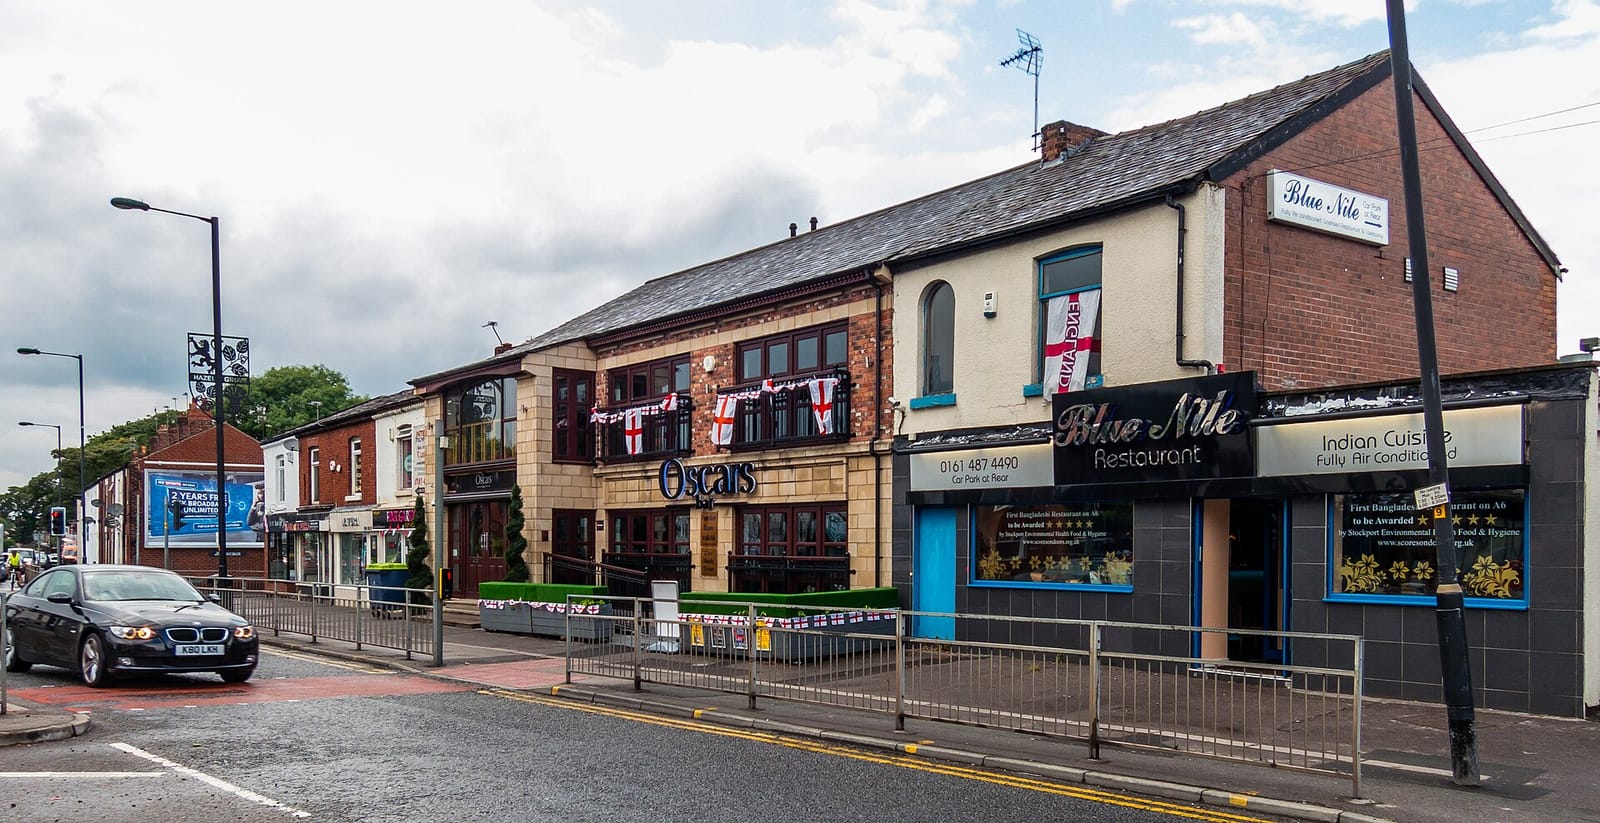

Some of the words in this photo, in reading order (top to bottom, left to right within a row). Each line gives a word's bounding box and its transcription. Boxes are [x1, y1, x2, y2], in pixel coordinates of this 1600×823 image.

[1284, 179, 1323, 211] Blue
[1327, 192, 1360, 221] Nile
[194, 374, 215, 382] HAZEL
[1054, 402, 1144, 447] Blue
[1148, 389, 1240, 440] Nile
[1322, 433, 1377, 451] Indian
[1384, 429, 1453, 447] Cuisie
[1095, 444, 1201, 470] Restaurant
[1316, 453, 1346, 468] Fully
[1352, 452, 1370, 465] Air
[1374, 446, 1457, 464] Conditiod
[940, 460, 964, 473] 0161
[968, 458, 988, 471] 487
[991, 456, 1018, 470] 4490
[659, 458, 758, 499] Oscars
[952, 475, 963, 484] Car
[965, 474, 980, 484] Park
[982, 475, 990, 483] at
[991, 473, 1009, 482] Rear
[171, 492, 178, 500] 2
[180, 492, 208, 501] YEARS
[696, 494, 716, 509] bar
[1350, 503, 1370, 512] First
[1372, 503, 1417, 513] Banglades
[1492, 501, 1506, 509] A6
[1436, 508, 1442, 516] 9
[1006, 511, 1018, 519] First
[1051, 511, 1081, 519] Restaurant
[1353, 517, 1362, 525] to
[1363, 516, 1374, 525] be
[1375, 516, 1414, 525] Awarded
[1338, 529, 1346, 538] by
[1347, 528, 1380, 538] Stockport
[1381, 528, 1431, 536] Environmental
[1458, 528, 1477, 536] Food
[1478, 528, 1486, 536] &
[1488, 528, 1520, 538] Hygiene
[1377, 538, 1474, 549] www.scoresondrg.uk
